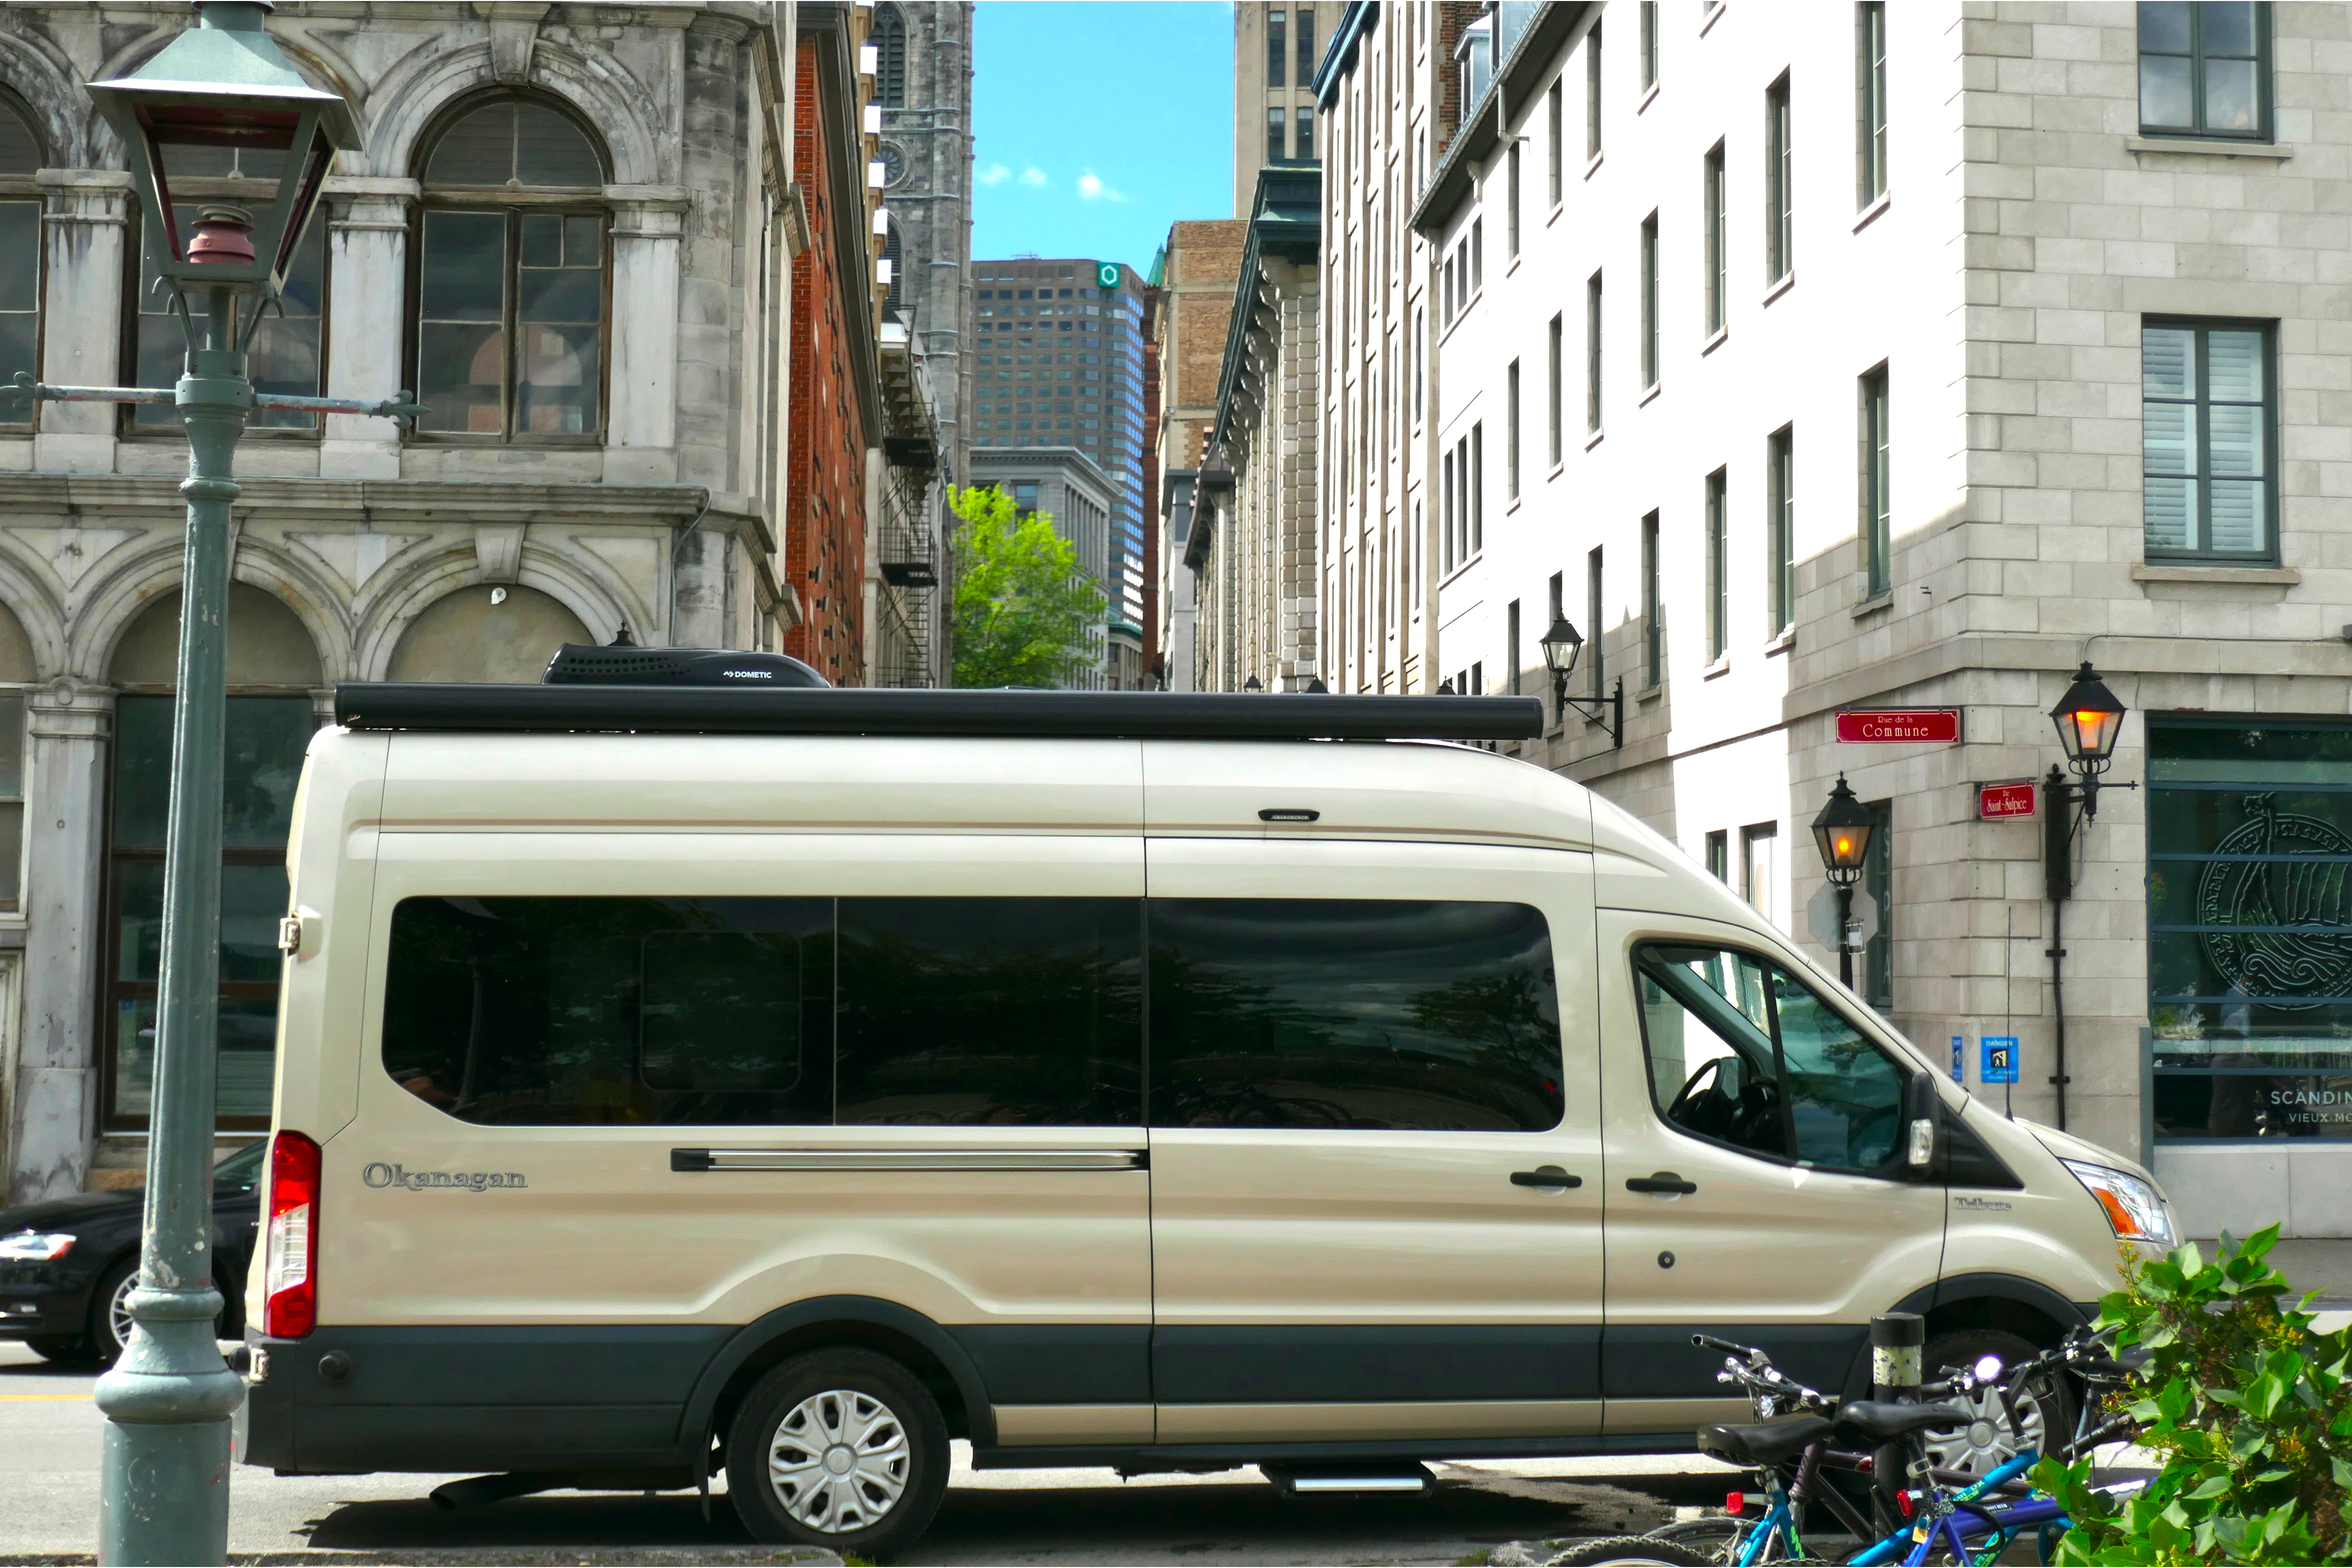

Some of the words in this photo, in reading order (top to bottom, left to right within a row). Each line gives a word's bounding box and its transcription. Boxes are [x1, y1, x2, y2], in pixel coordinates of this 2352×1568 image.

[1862, 724, 1929, 737] Commune
[1987, 797, 2027, 814] Saint-Sulpice
[362, 1162, 528, 1192] Okanagan
